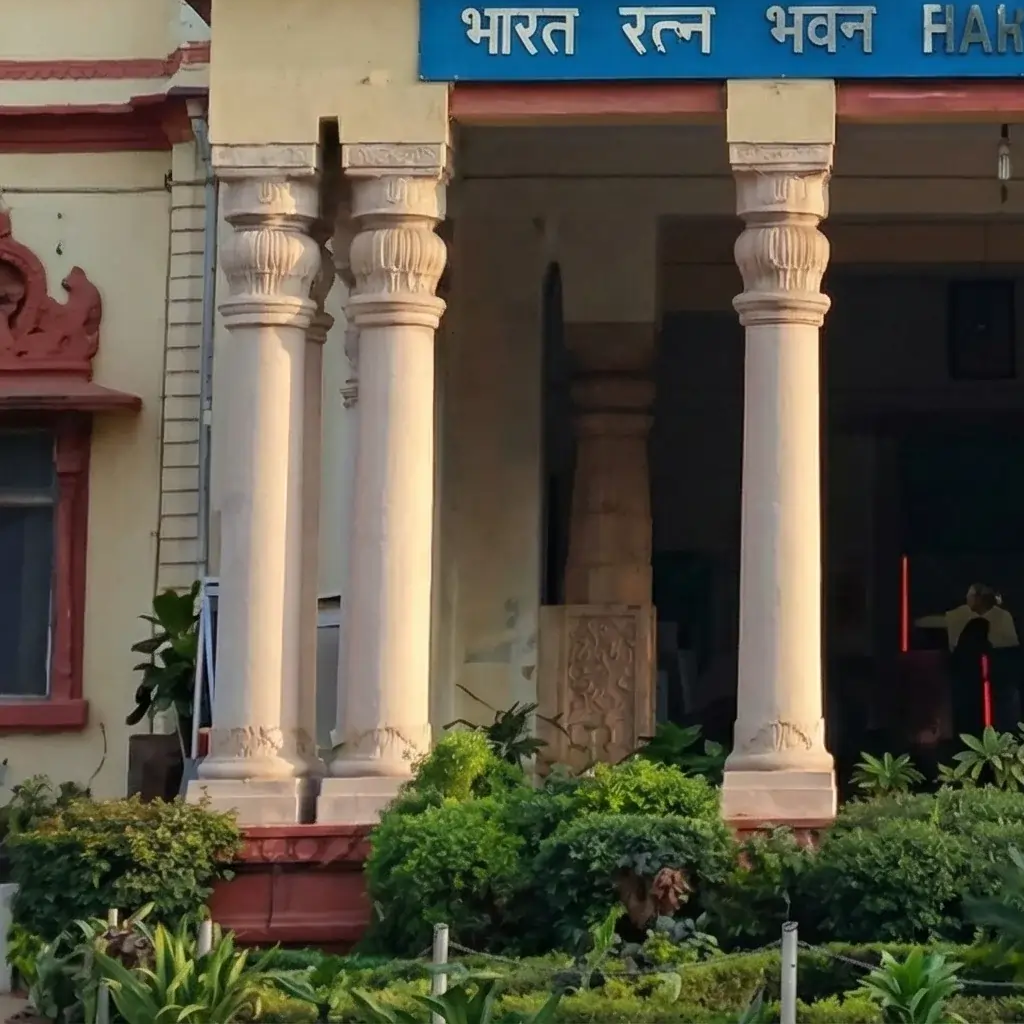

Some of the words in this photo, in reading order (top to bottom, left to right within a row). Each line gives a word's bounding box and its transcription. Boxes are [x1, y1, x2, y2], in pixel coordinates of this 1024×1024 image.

[461, 7, 579, 55] भारत
[618, 6, 716, 55] रत्न
[765, 5, 877, 54] भवन
